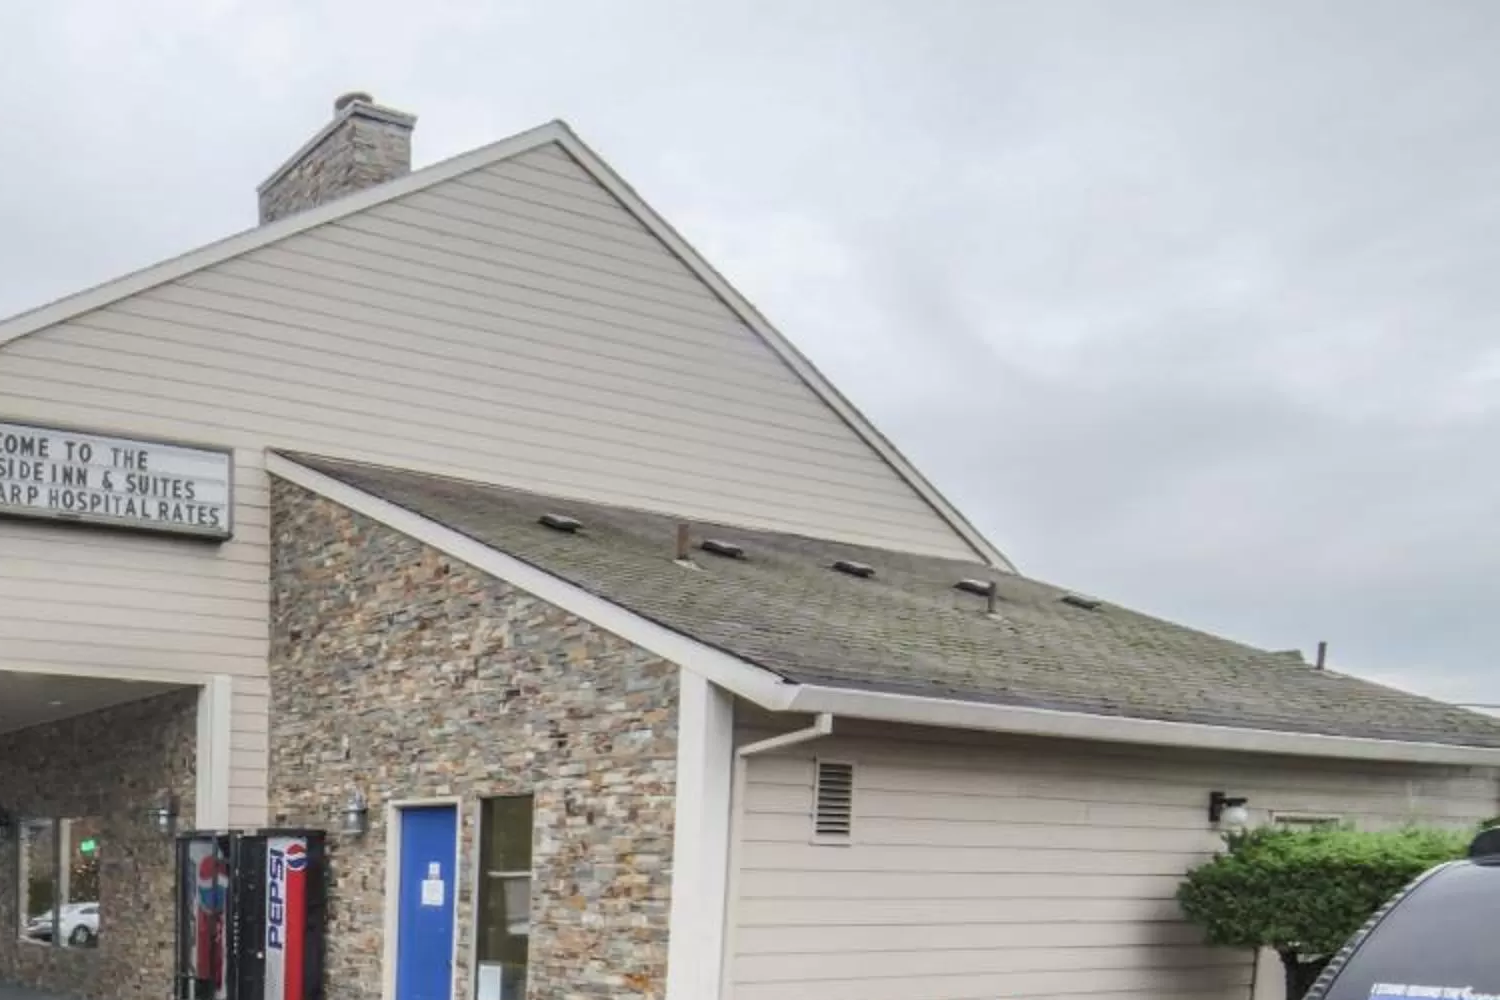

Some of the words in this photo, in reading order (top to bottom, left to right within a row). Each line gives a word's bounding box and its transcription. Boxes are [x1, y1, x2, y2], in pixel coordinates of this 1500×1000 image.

[64, 441, 93, 463] TO
[112, 447, 149, 471] THE
[52, 466, 88, 486] INN
[102, 470, 114, 492] &
[125, 475, 196, 500] SUITES
[49, 490, 150, 518] HOSPITAL
[158, 501, 220, 526] RATES
[268, 848, 285, 950] PEPSI
